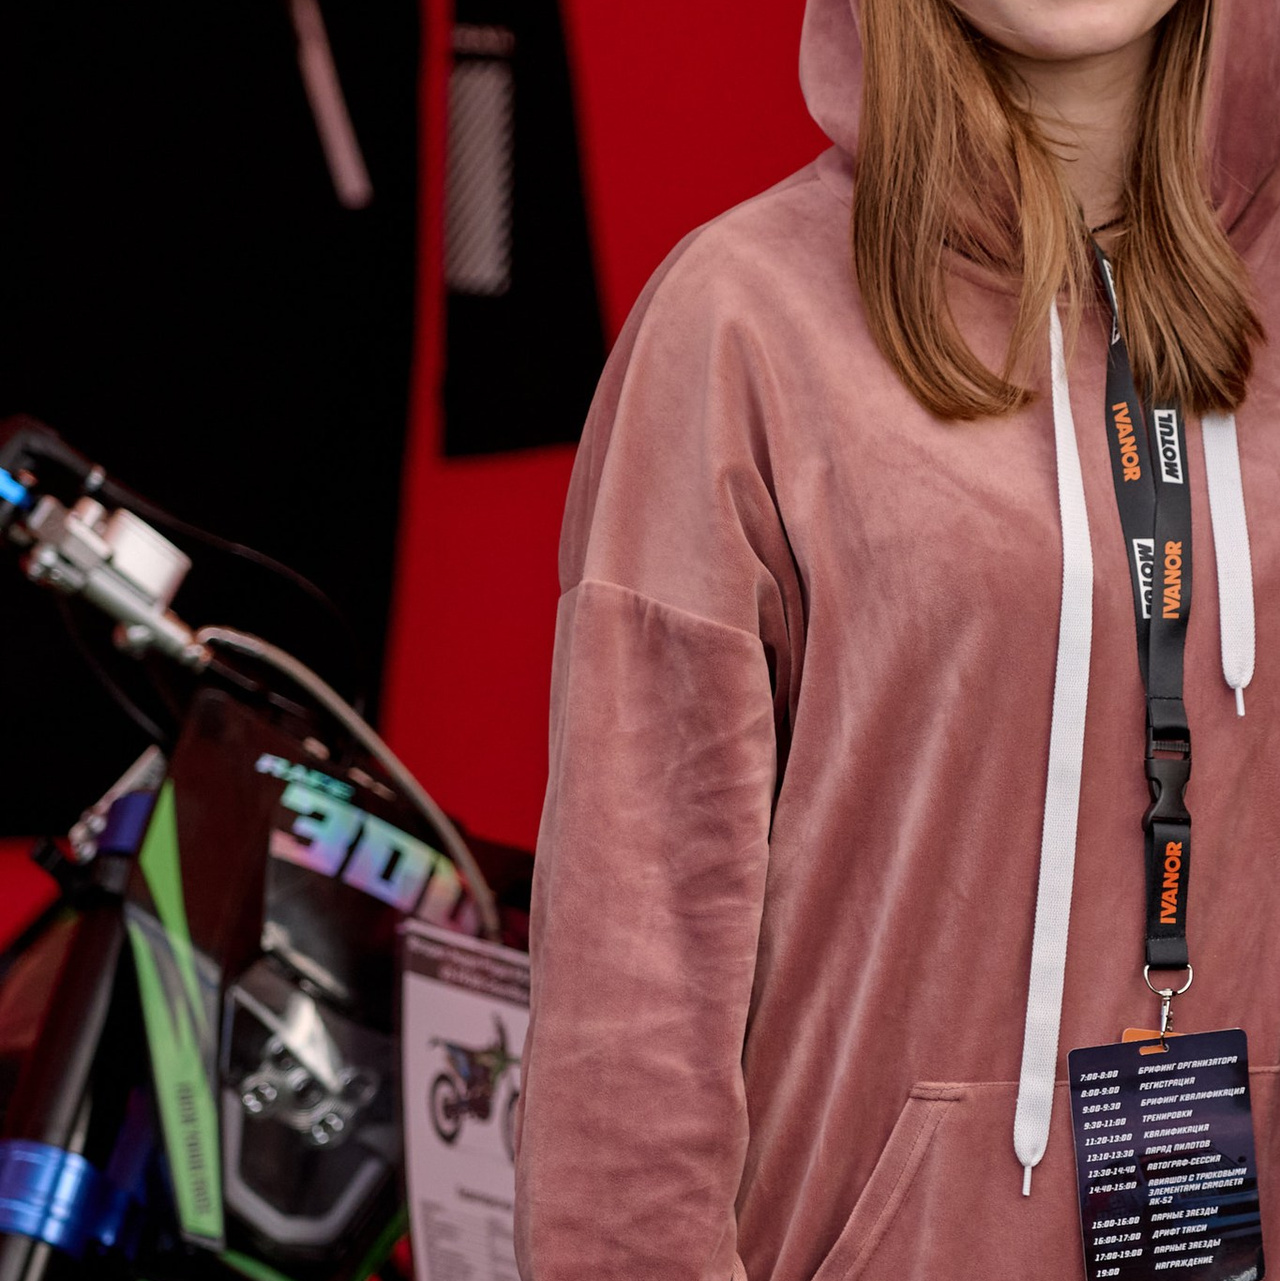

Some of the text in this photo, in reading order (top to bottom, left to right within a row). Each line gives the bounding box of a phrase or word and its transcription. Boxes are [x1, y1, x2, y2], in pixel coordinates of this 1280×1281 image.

[1111, 401, 1141, 482] IVANOR
[1157, 411, 1181, 480] MOTUL
[1162, 540, 1183, 619] IVANOR
[1160, 841, 1182, 924] IVANOR
[1080, 1056, 1238, 1082] 7:00-8:00 БРИФИНГ ОРГАНИЗАТОРА
[1081, 1077, 1195, 1098] 8:00-9:00 РЕГИСТРАЦИЯ
[1082, 1087, 1246, 1114] 9:00-9:30 БРИФИНГ КВАЛИФИКАЦИЯ
[1083, 1109, 1193, 1130] 9:30-11:00 ТРЕНИРОВКИ
[1085, 1124, 1210, 1146] 11:20-13:00 КВАЛИФИКАЦИЯ
[1087, 1140, 1211, 1162] 13:10-13:30 ПАРАД ПИЛОТОВ
[1088, 1154, 1221, 1178] 13:30-14:40 АВТОГРАФ-СЕССИЯ
[1089, 1181, 1137, 1194] 14:40-15:00
[1148, 1175, 1188, 1187] АВИАШОУ
[1196, 1168, 1247, 1181] ТРЮКОВЫМИ
[1148, 1178, 1244, 1196] ЭЛЕМЕНТАМИ САМОЛЕТА
[1092, 1206, 1219, 1229] 15:00-16:00 ПАРНЫЕ ЗАЕЗДЫ
[1093, 1224, 1208, 1246] 16:00-17:00 ДРИФТ ТАКСИ
[1095, 1239, 1222, 1262] 17:00-19:00 ПАРНЫЕ ЗАЕЗДЫ
[1096, 1256, 1214, 1278] 19:00 НАГРАЖДЕНИЕ
